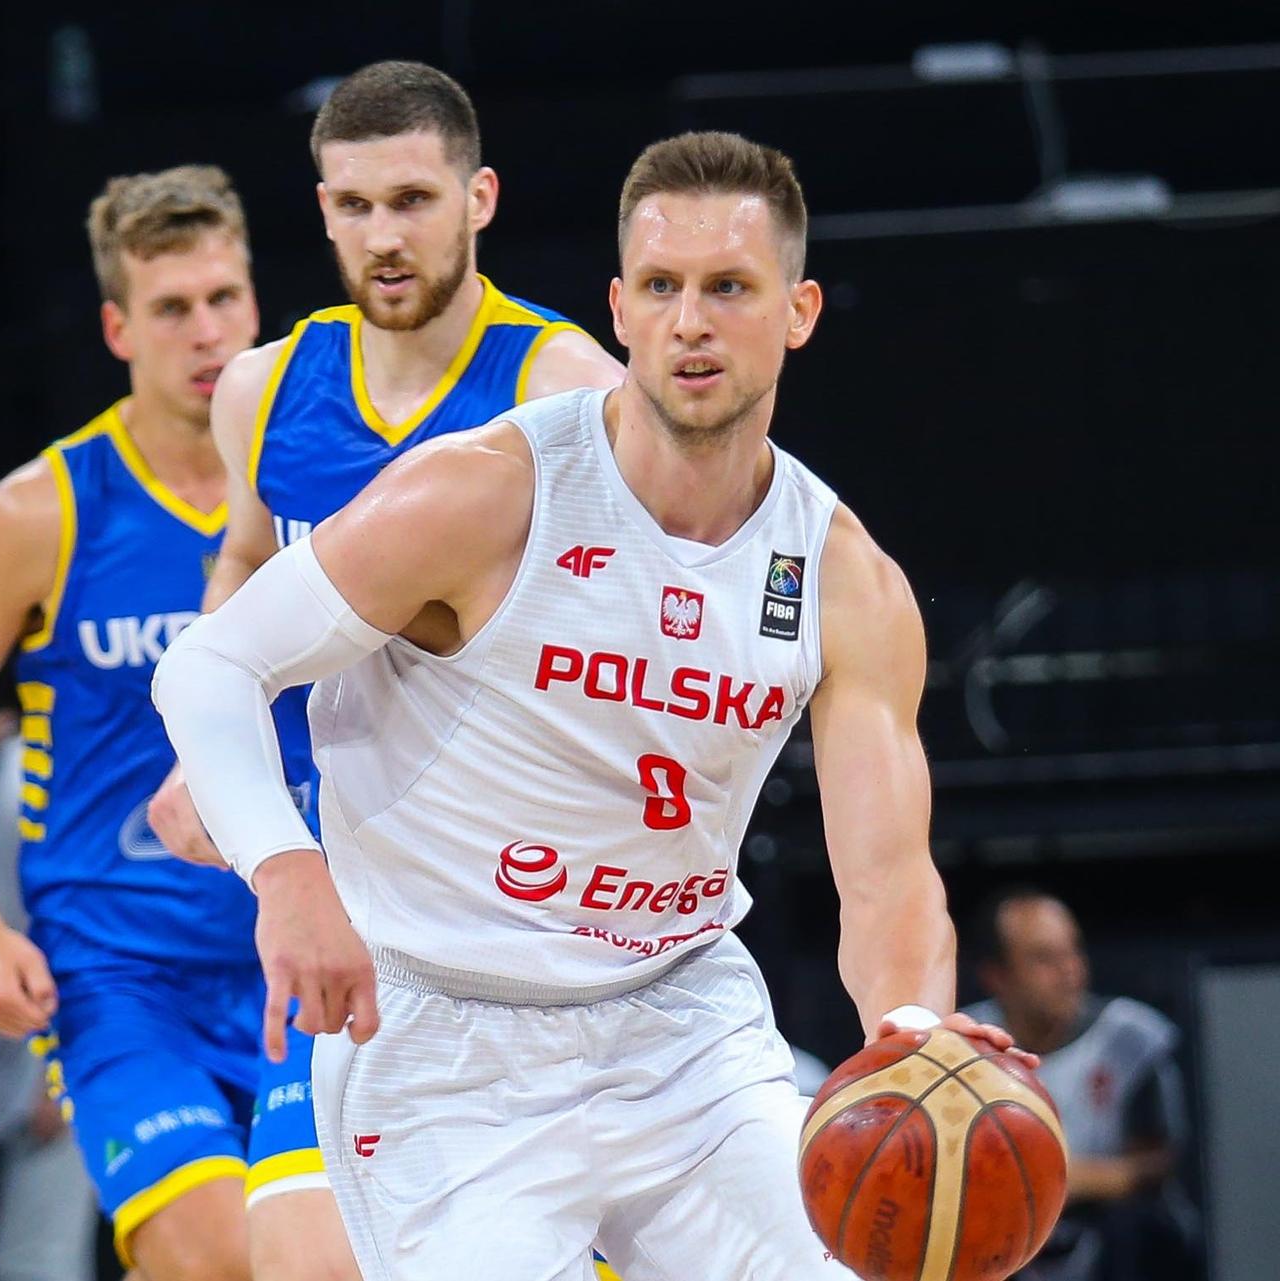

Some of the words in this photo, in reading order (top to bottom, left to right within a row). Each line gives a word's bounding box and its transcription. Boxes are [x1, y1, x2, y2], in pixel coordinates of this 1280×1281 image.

[555, 544, 617, 579] 4F
[766, 601, 795, 620] FIBA
[533, 643, 786, 730] POLSKA
